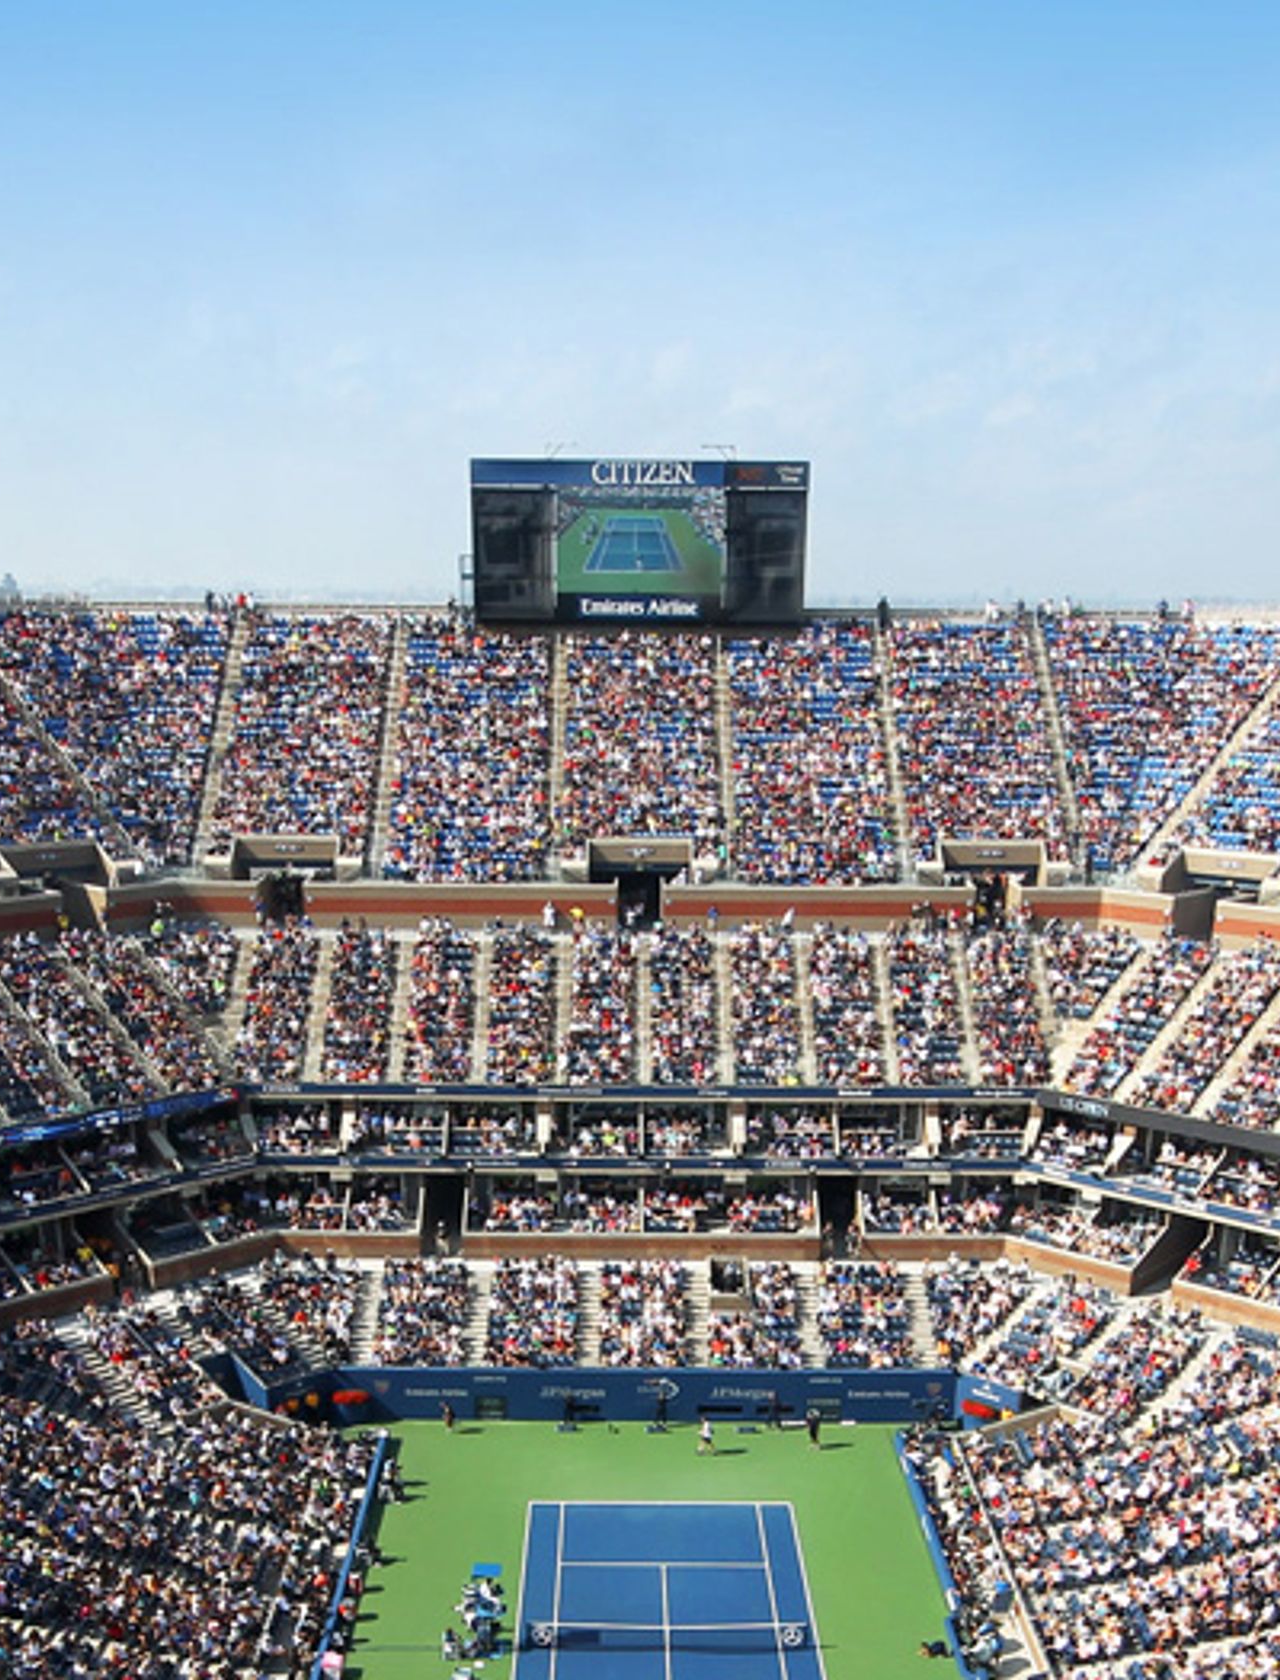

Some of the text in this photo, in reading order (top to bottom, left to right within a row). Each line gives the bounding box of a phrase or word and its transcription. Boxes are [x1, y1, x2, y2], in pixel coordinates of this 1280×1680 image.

[592, 461, 696, 484] CITIZEN
[581, 598, 698, 615] Emirates Airline
